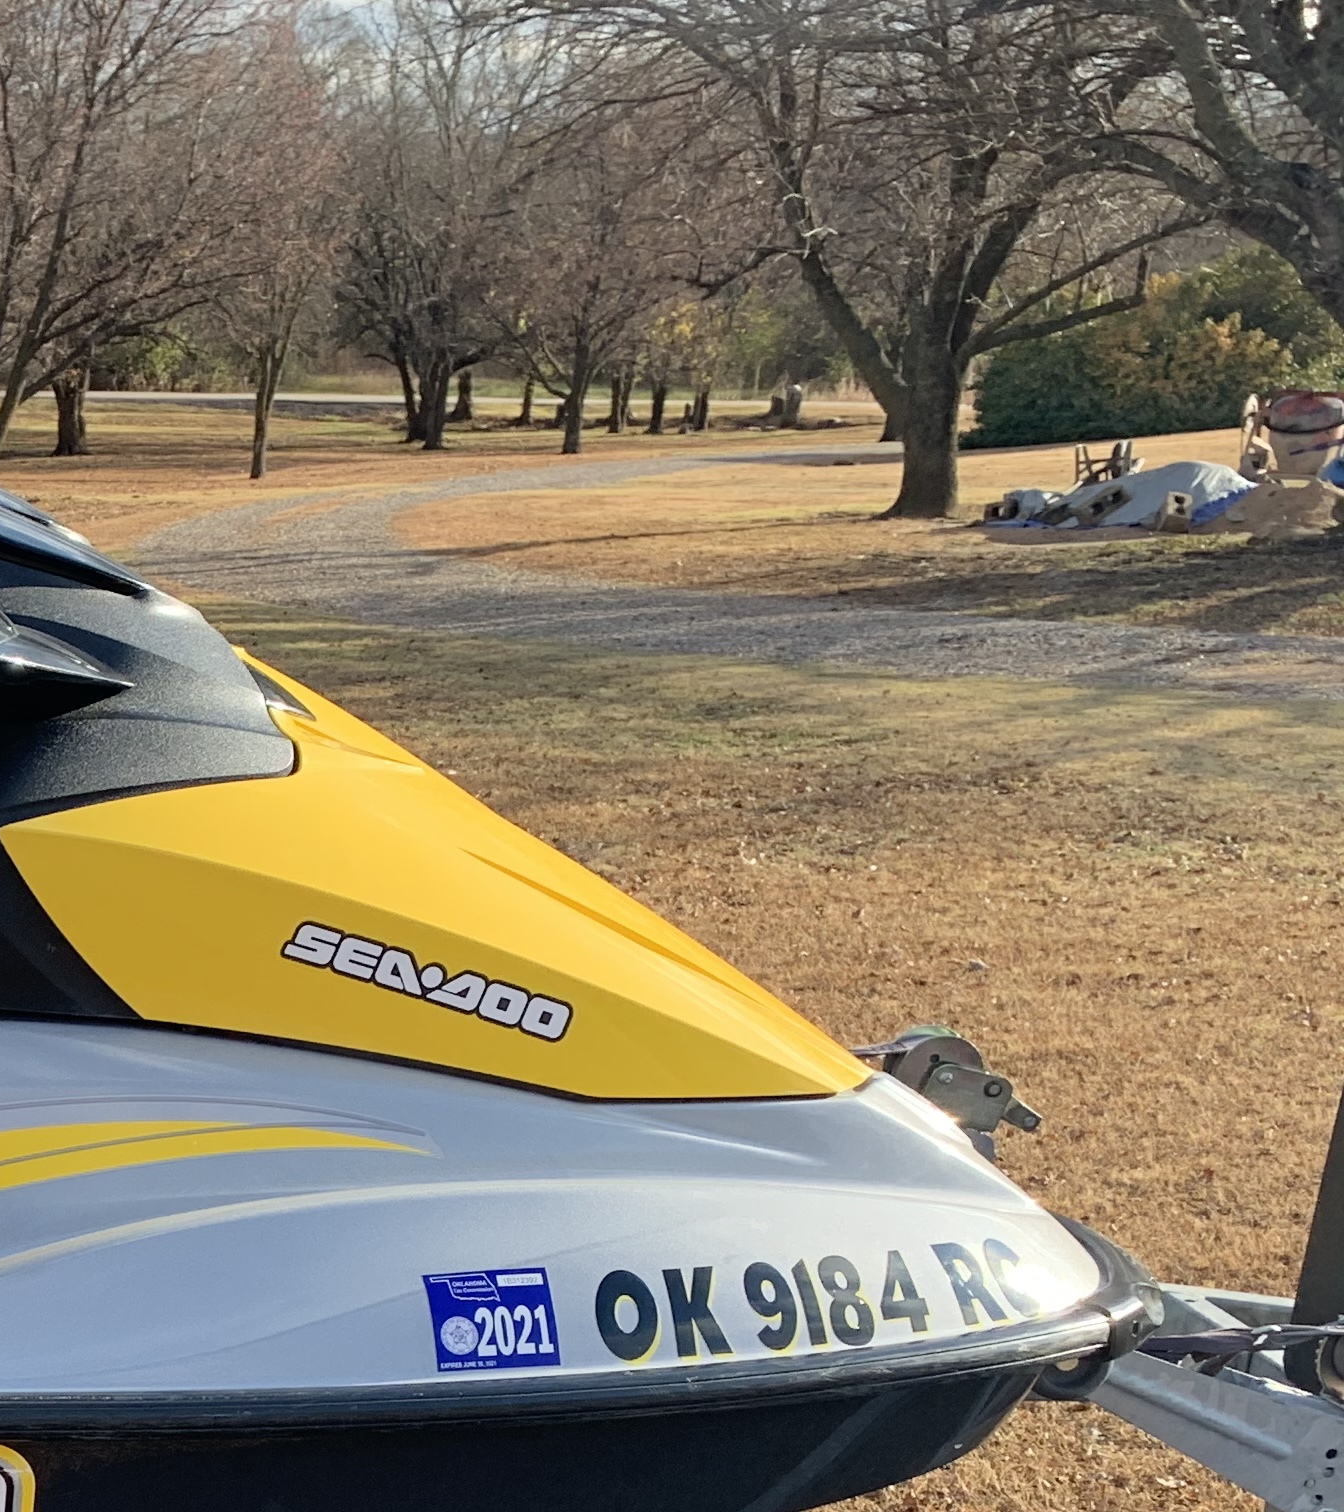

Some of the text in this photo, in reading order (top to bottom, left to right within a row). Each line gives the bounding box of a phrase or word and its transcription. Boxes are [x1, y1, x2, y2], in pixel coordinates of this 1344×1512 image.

[474, 1304, 555, 1357] 2021
[595, 1266, 734, 1362] OK
[743, 1250, 931, 1350] 9184
